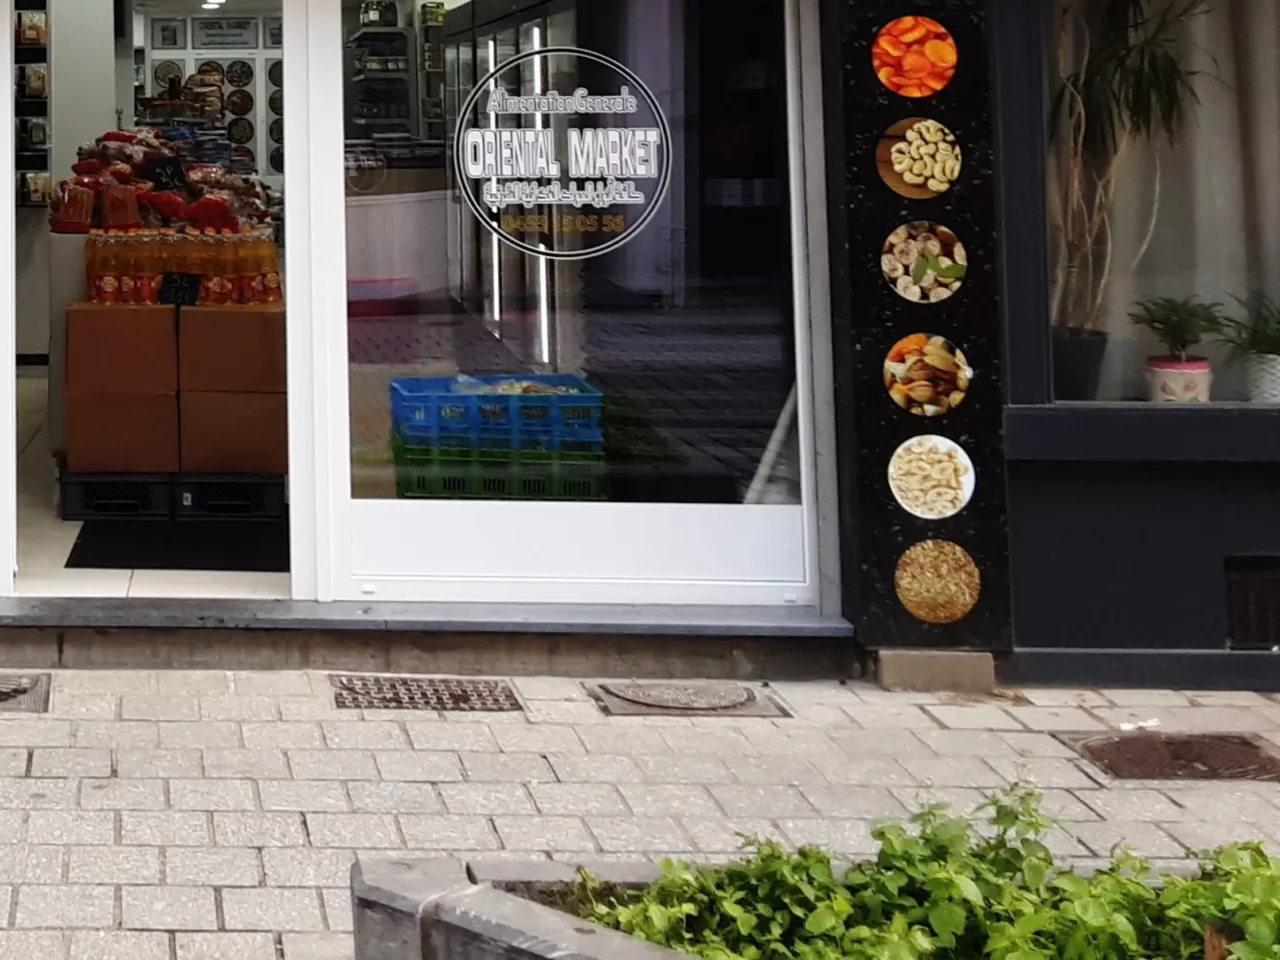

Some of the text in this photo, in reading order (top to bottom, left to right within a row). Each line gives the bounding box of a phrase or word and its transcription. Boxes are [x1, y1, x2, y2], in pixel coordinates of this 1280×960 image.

[487, 86, 638, 113] Alimentation Generale
[465, 128, 660, 178] ORIENTAL MARKET
